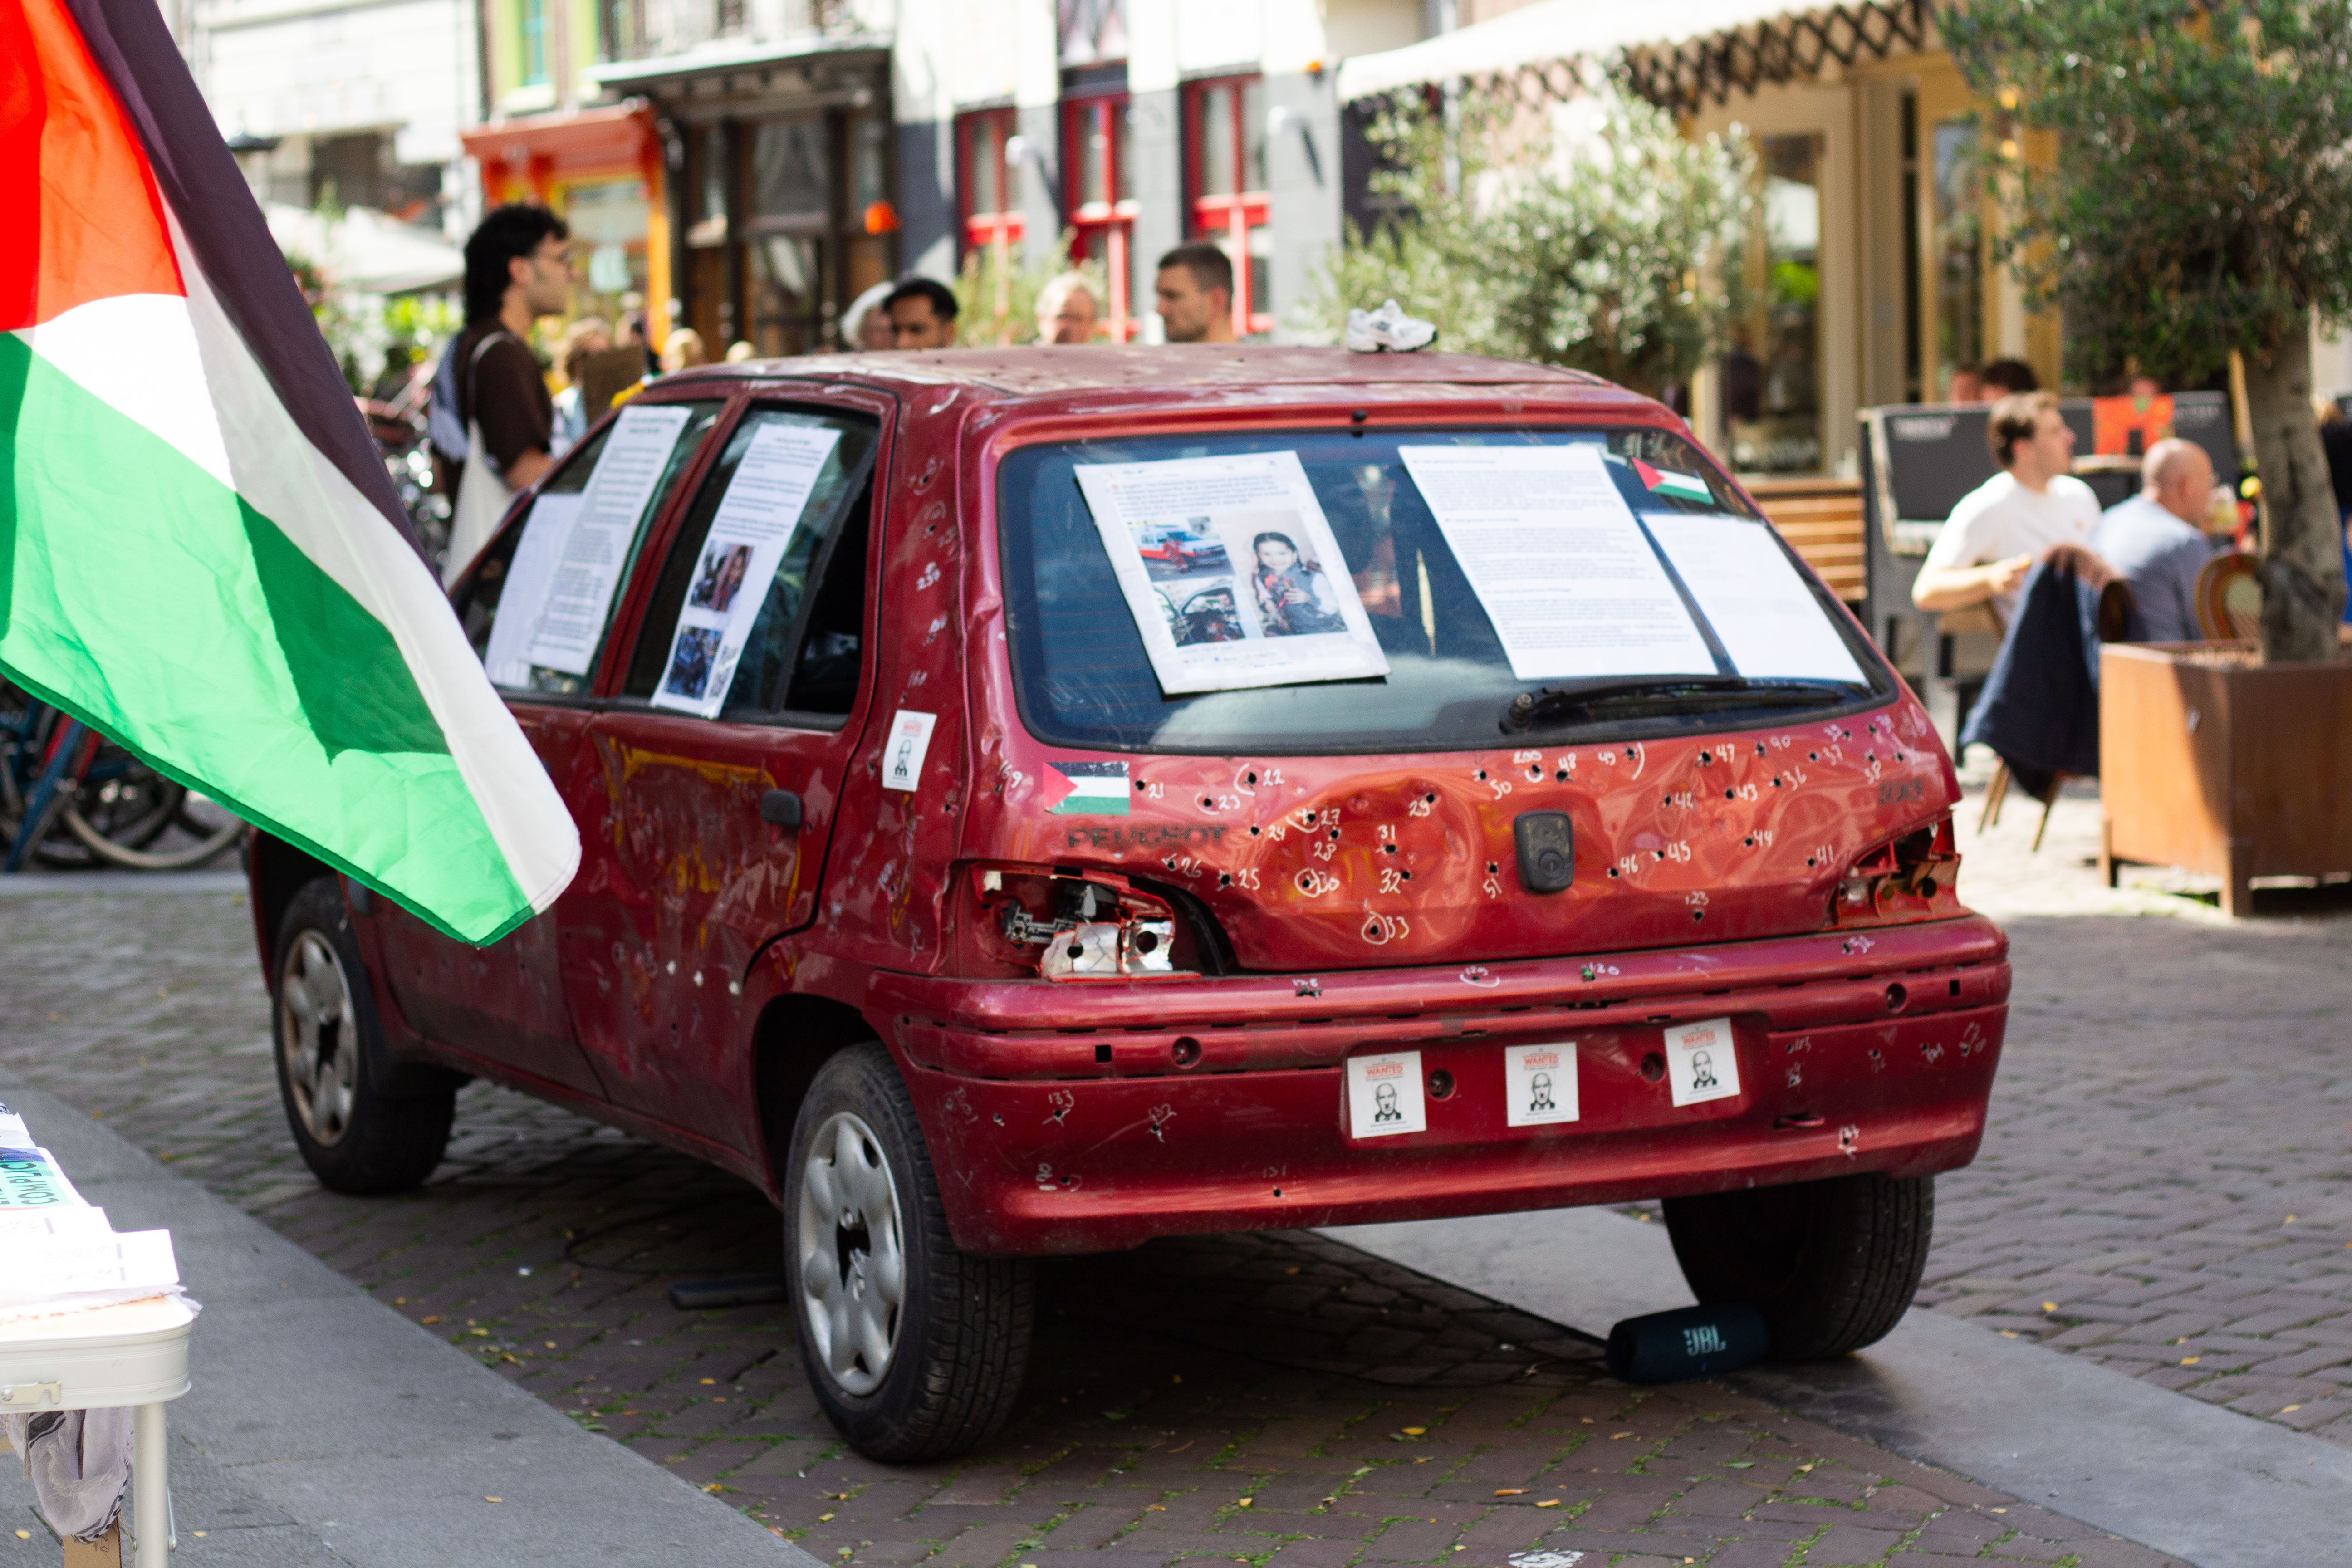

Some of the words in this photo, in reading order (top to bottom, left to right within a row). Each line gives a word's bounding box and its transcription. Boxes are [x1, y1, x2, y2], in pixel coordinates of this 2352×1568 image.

[1558, 752, 1576, 771] 48
[1716, 743, 1735, 763] 47
[1823, 744, 1843, 766] 37
[1263, 769, 1284, 785] 22
[1783, 765, 1807, 791] 36
[1148, 782, 1164, 799] 21
[1490, 779, 1512, 800] 50
[1736, 783, 1758, 802] 43
[1218, 794, 1240, 809] 23
[1409, 800, 1430, 817] 29
[1675, 792, 1694, 809] 42
[1321, 808, 1340, 825] 27
[1068, 825, 1229, 850] PEUGEOT
[1269, 825, 1285, 841] 24
[1377, 824, 1396, 840] 31
[1753, 829, 1773, 848] 44
[1314, 841, 1337, 861] 28
[1667, 840, 1691, 862] 45
[1816, 844, 1834, 865] 41
[1182, 857, 1201, 877] 26
[1620, 853, 1638, 874] 46
[1239, 867, 1261, 890] 25
[1380, 868, 1401, 894] 32
[1483, 878, 1502, 899] 51
[1386, 916, 1410, 939] 33
[1524, 1054, 1559, 1065] WANTED
[1366, 1064, 1403, 1076] WANTED
[1048, 1089, 1075, 1108] 133
[1683, 1324, 1726, 1356] JBL
